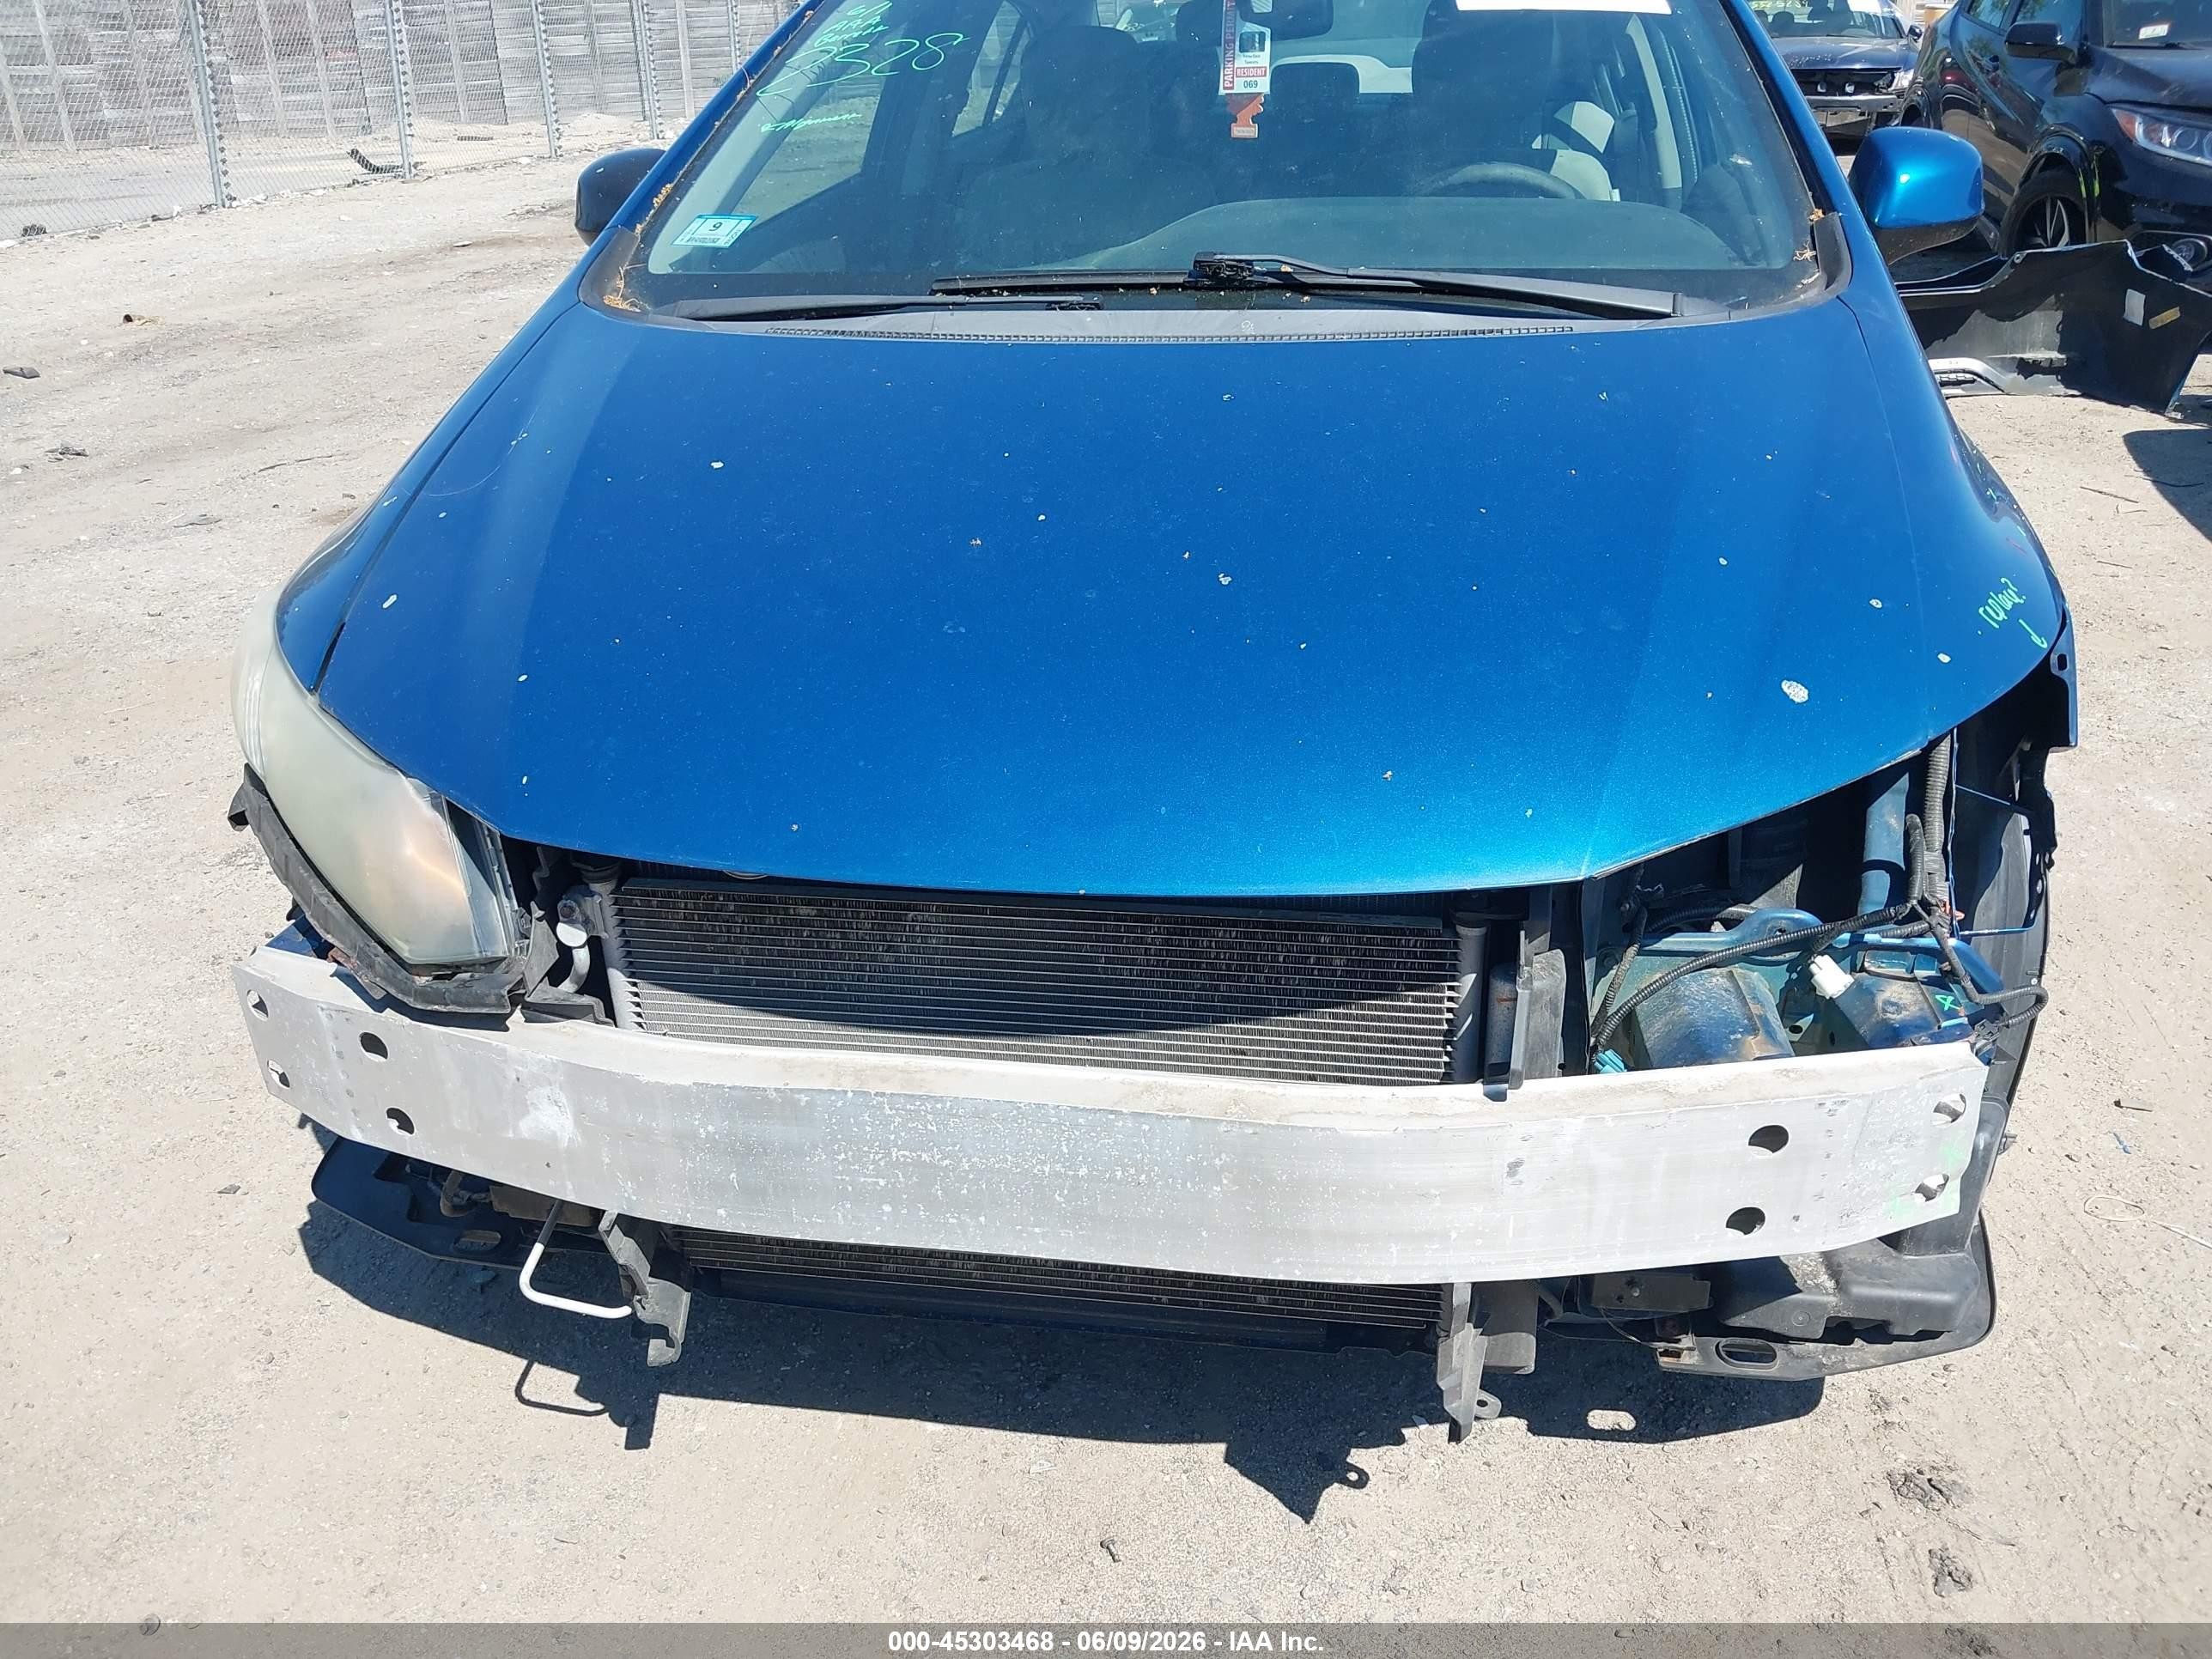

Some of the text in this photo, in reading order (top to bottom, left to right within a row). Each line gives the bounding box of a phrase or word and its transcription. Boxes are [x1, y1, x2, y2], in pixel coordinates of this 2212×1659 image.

[1224, 2, 1236, 87] PARKING PERMIT
[1237, 67, 1266, 77] RESIDENT
[1243, 80, 1258, 88] 069
[709, 222, 723, 232] 9
